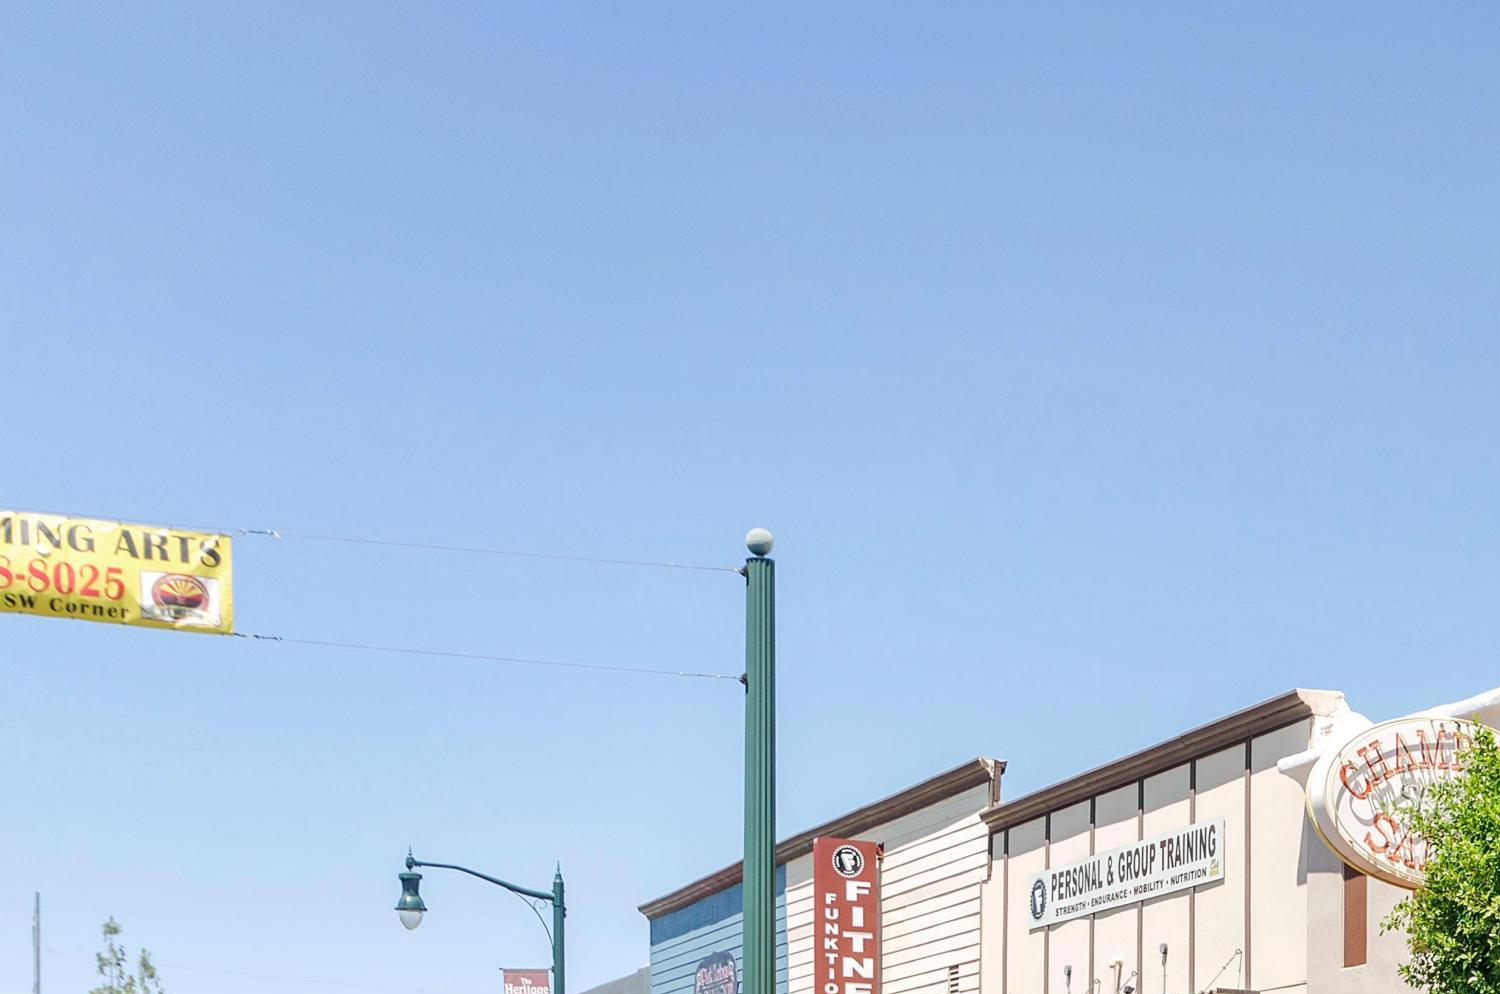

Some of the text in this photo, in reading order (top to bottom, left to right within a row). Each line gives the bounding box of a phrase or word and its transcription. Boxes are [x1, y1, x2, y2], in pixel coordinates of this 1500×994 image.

[115, 529, 221, 568] ARTS
[5, 594, 34, 608] SW
[49, 597, 129, 619] Corner
[1051, 859, 1103, 902] PERSONAL
[1107, 856, 1114, 886] &
[1118, 843, 1156, 883] GROUP
[1160, 824, 1216, 871] TRAINING
[1055, 901, 1087, 917] STRENGTH
[1091, 890, 1128, 907] ENDURANCE
[1133, 879, 1164, 895] MOBILITY
[1170, 867, 1207, 885] NUTRITION
[520, 977, 532, 985] The
